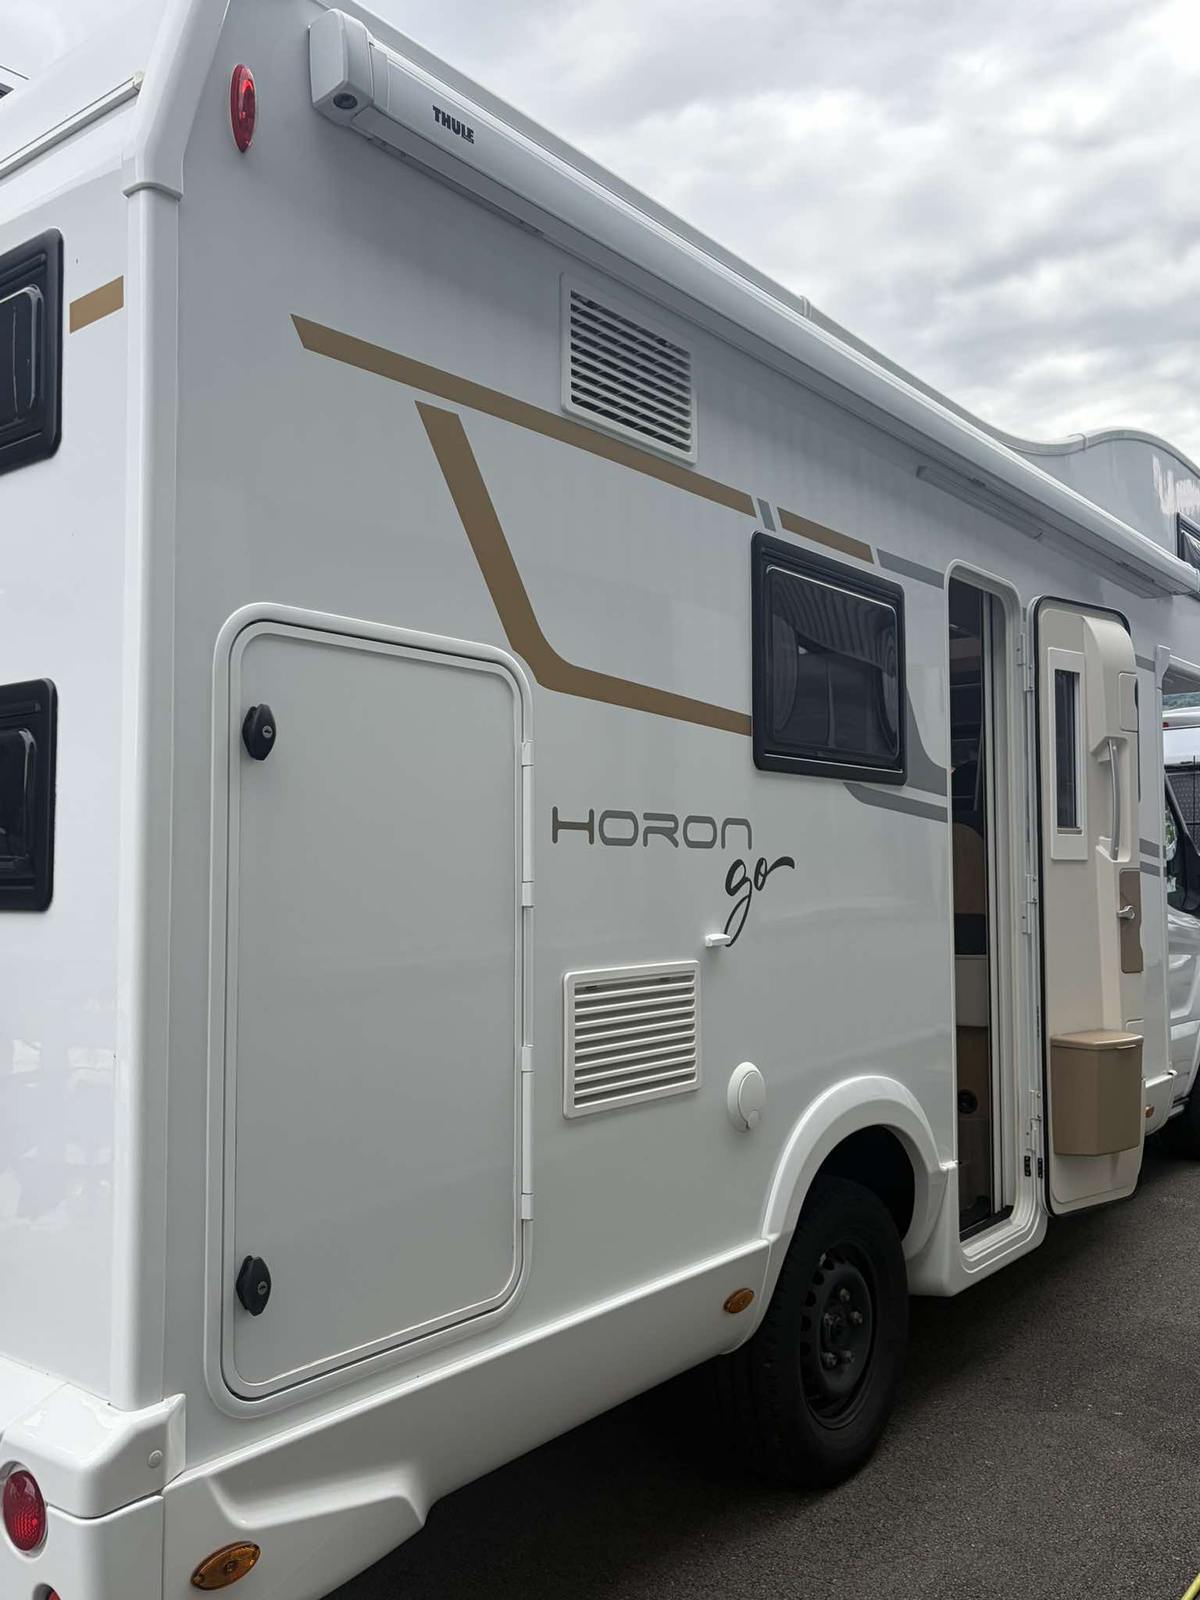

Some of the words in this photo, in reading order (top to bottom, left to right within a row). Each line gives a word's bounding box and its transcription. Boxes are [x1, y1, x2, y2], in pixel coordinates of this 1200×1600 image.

[432, 104, 475, 145] THULE
[552, 806, 752, 850] HORON
[725, 856, 795, 947] go
